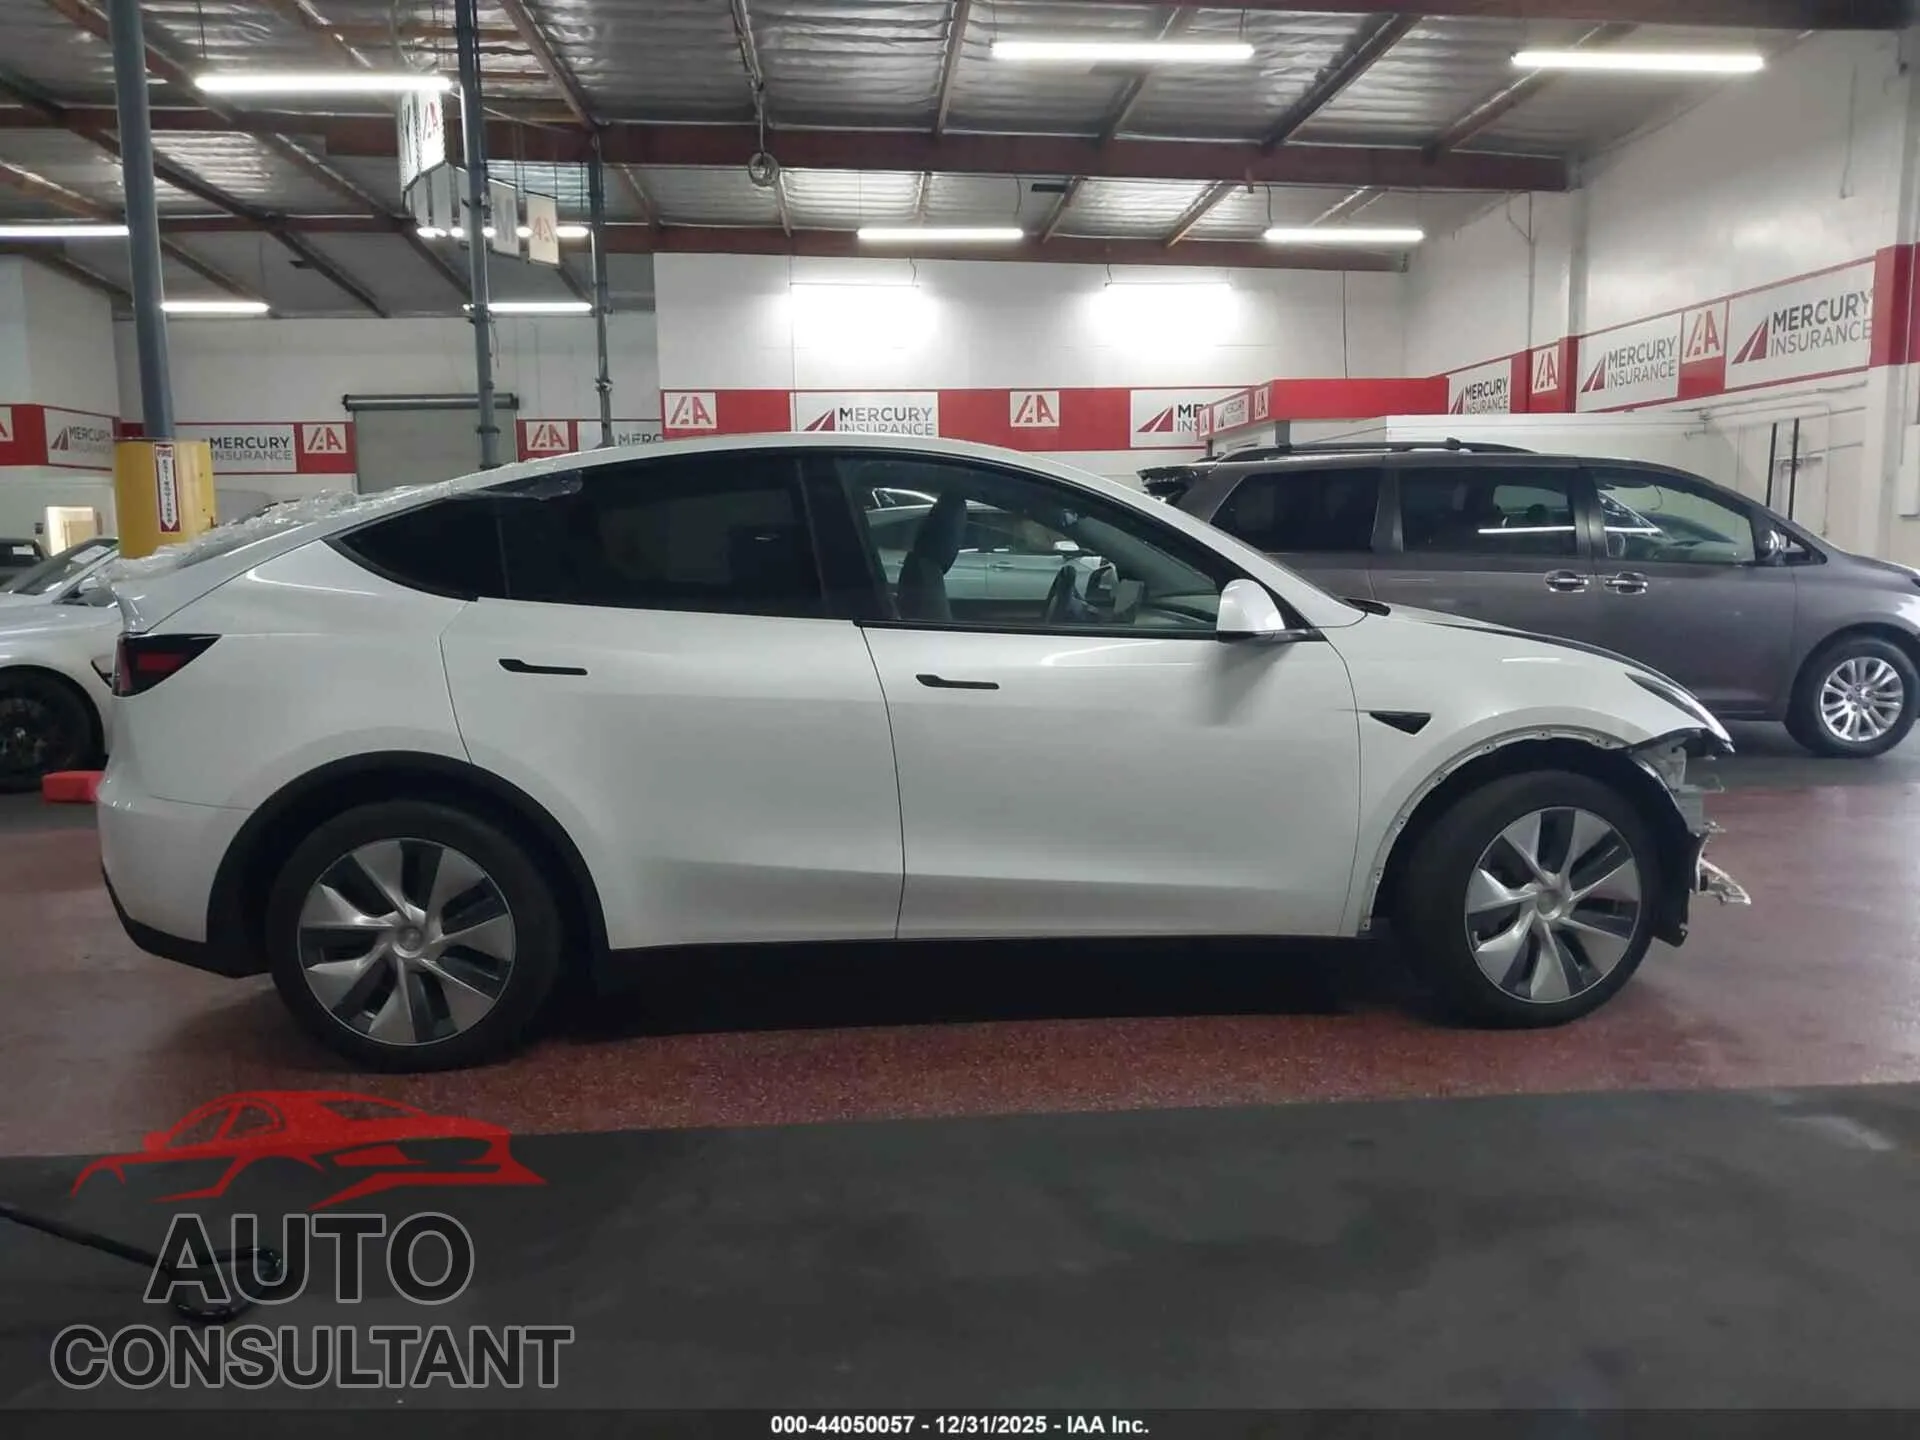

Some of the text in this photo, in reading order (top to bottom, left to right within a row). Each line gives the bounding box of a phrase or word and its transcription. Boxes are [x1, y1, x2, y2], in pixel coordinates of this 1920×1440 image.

[1772, 287, 1873, 335] MERCURY
[1770, 318, 1872, 357] INSURANCE
[1607, 335, 1677, 369] MERCURY
[1606, 359, 1676, 388] INSURANCE
[1465, 376, 1508, 401] MERCURY
[839, 407, 933, 422] MERCURY
[209, 436, 290, 449] MERCURY
[210, 449, 293, 461] INSURANCE
